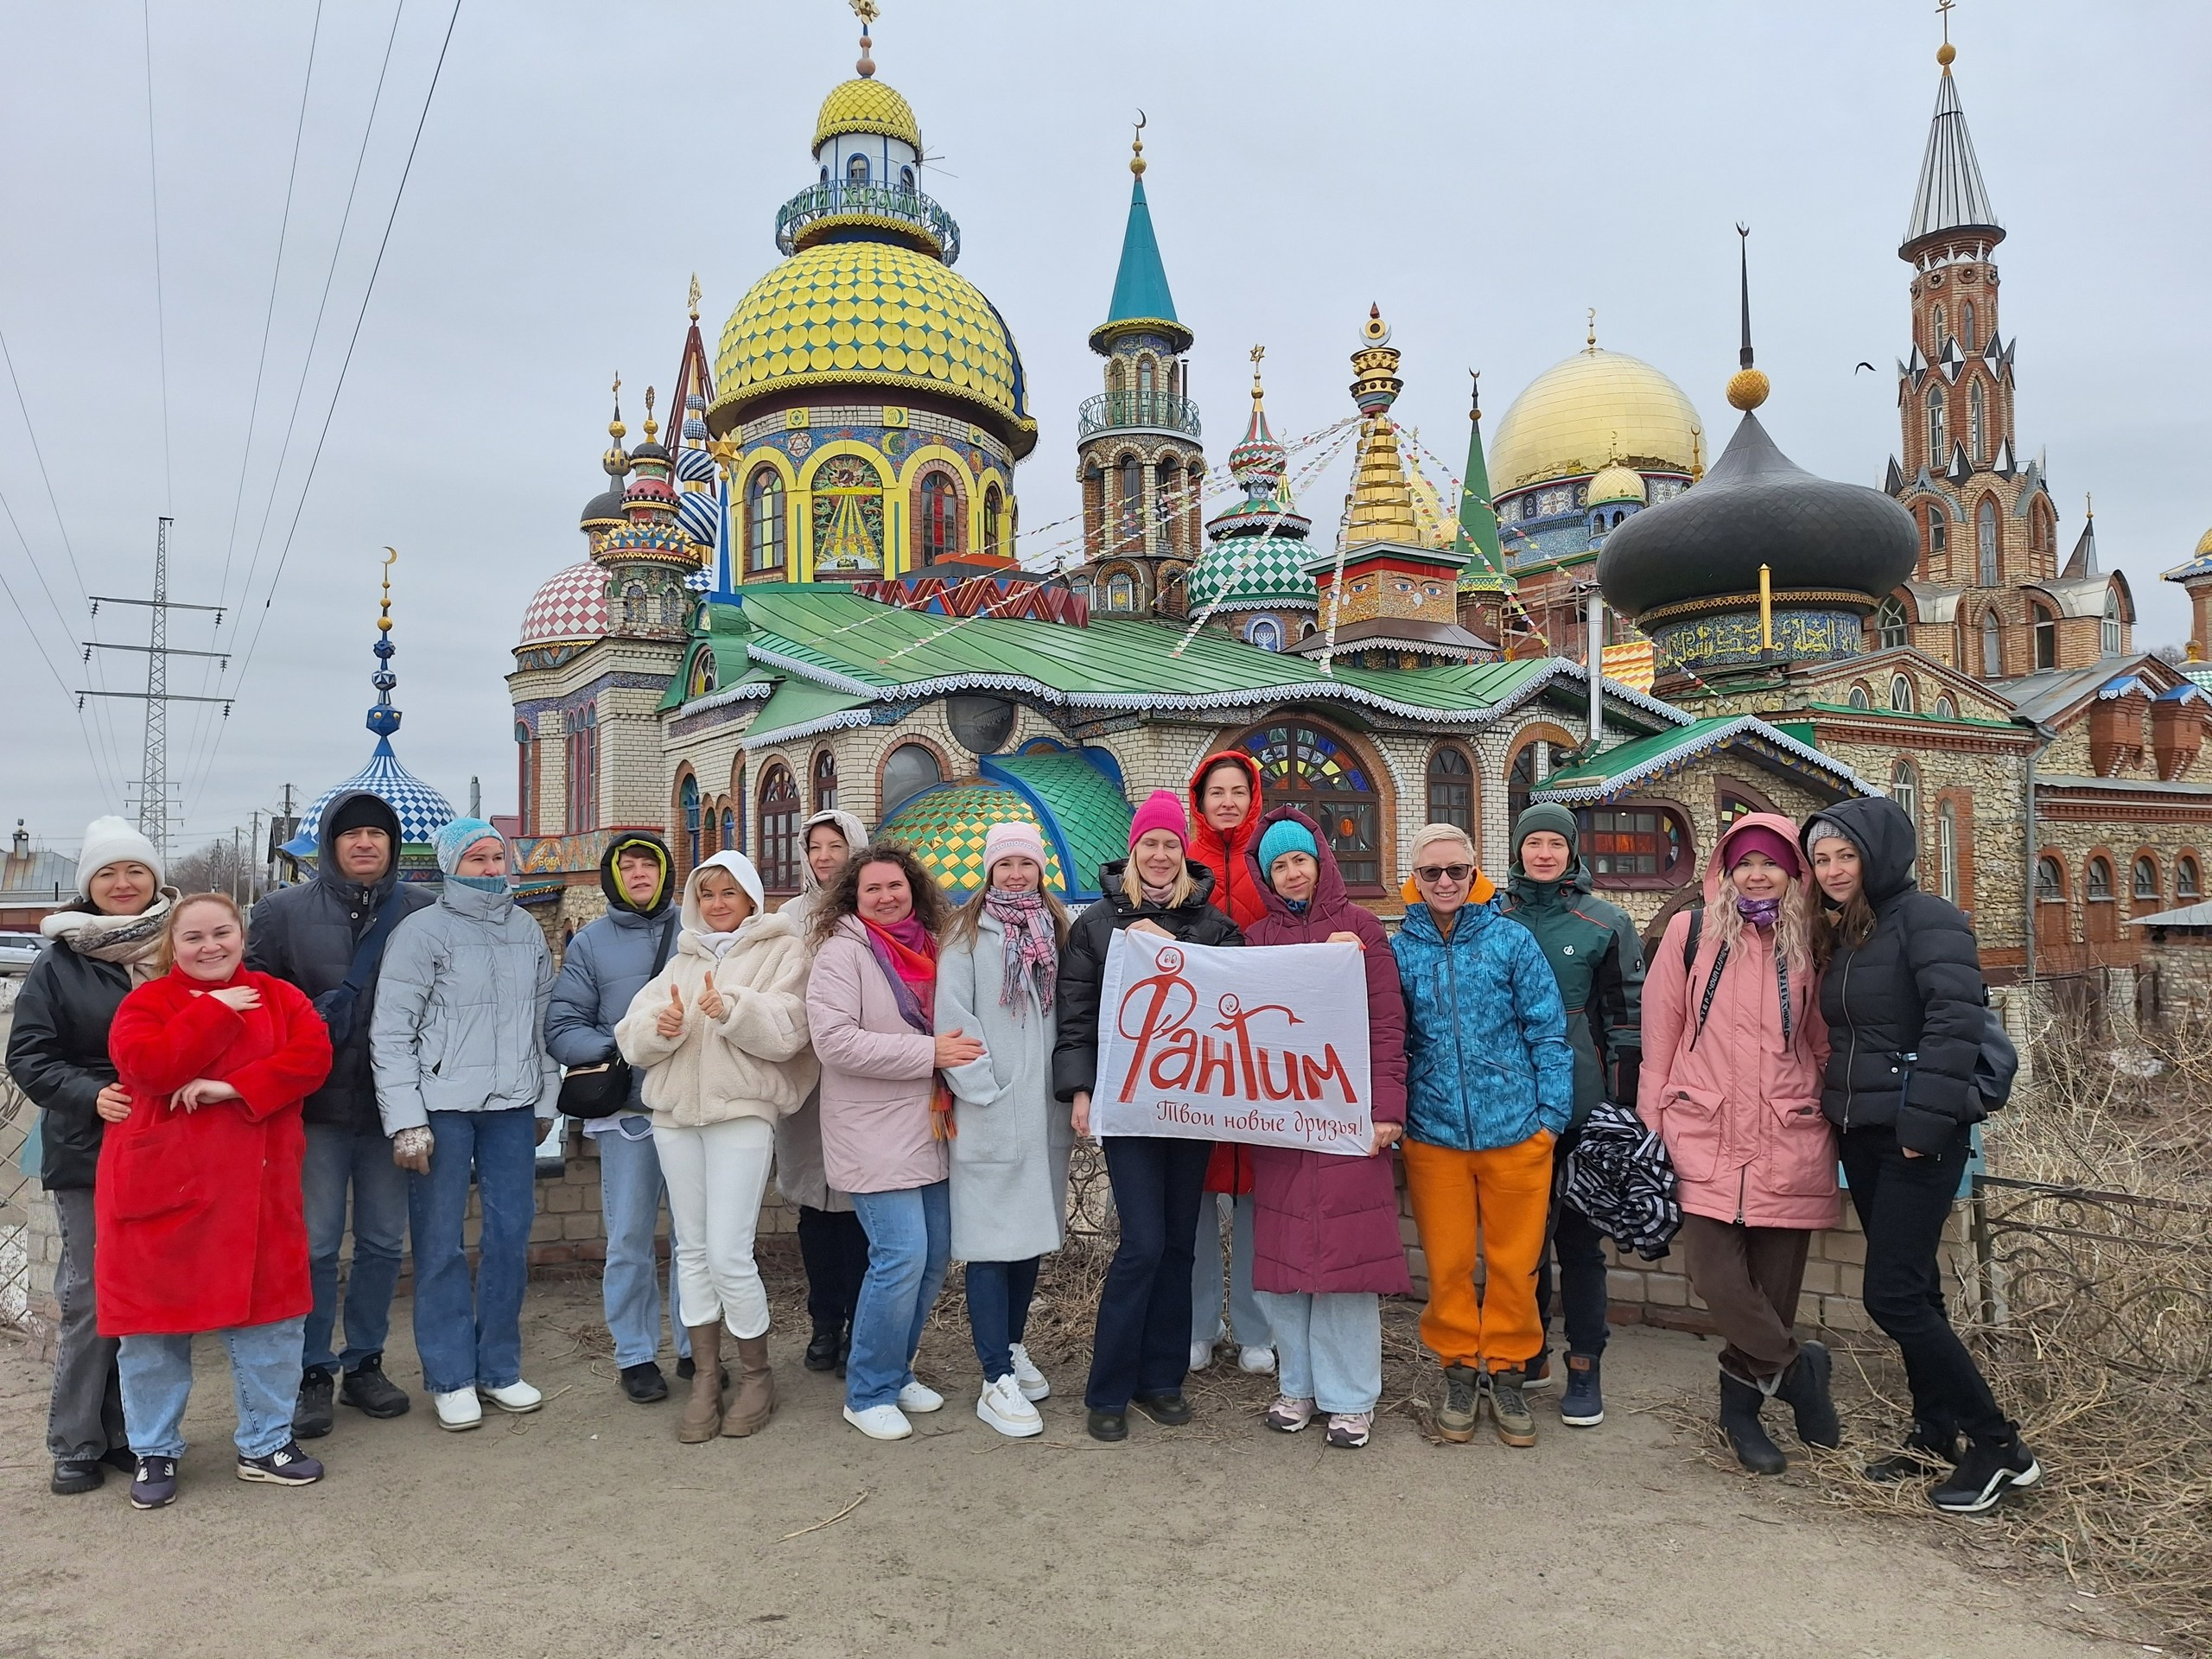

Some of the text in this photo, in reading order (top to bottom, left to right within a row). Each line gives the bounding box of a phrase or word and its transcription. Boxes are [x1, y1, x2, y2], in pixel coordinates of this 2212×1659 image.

[841, 186, 919, 217] ХРАМ
[1156, 1100, 1363, 1143] Твои новые друзья!
